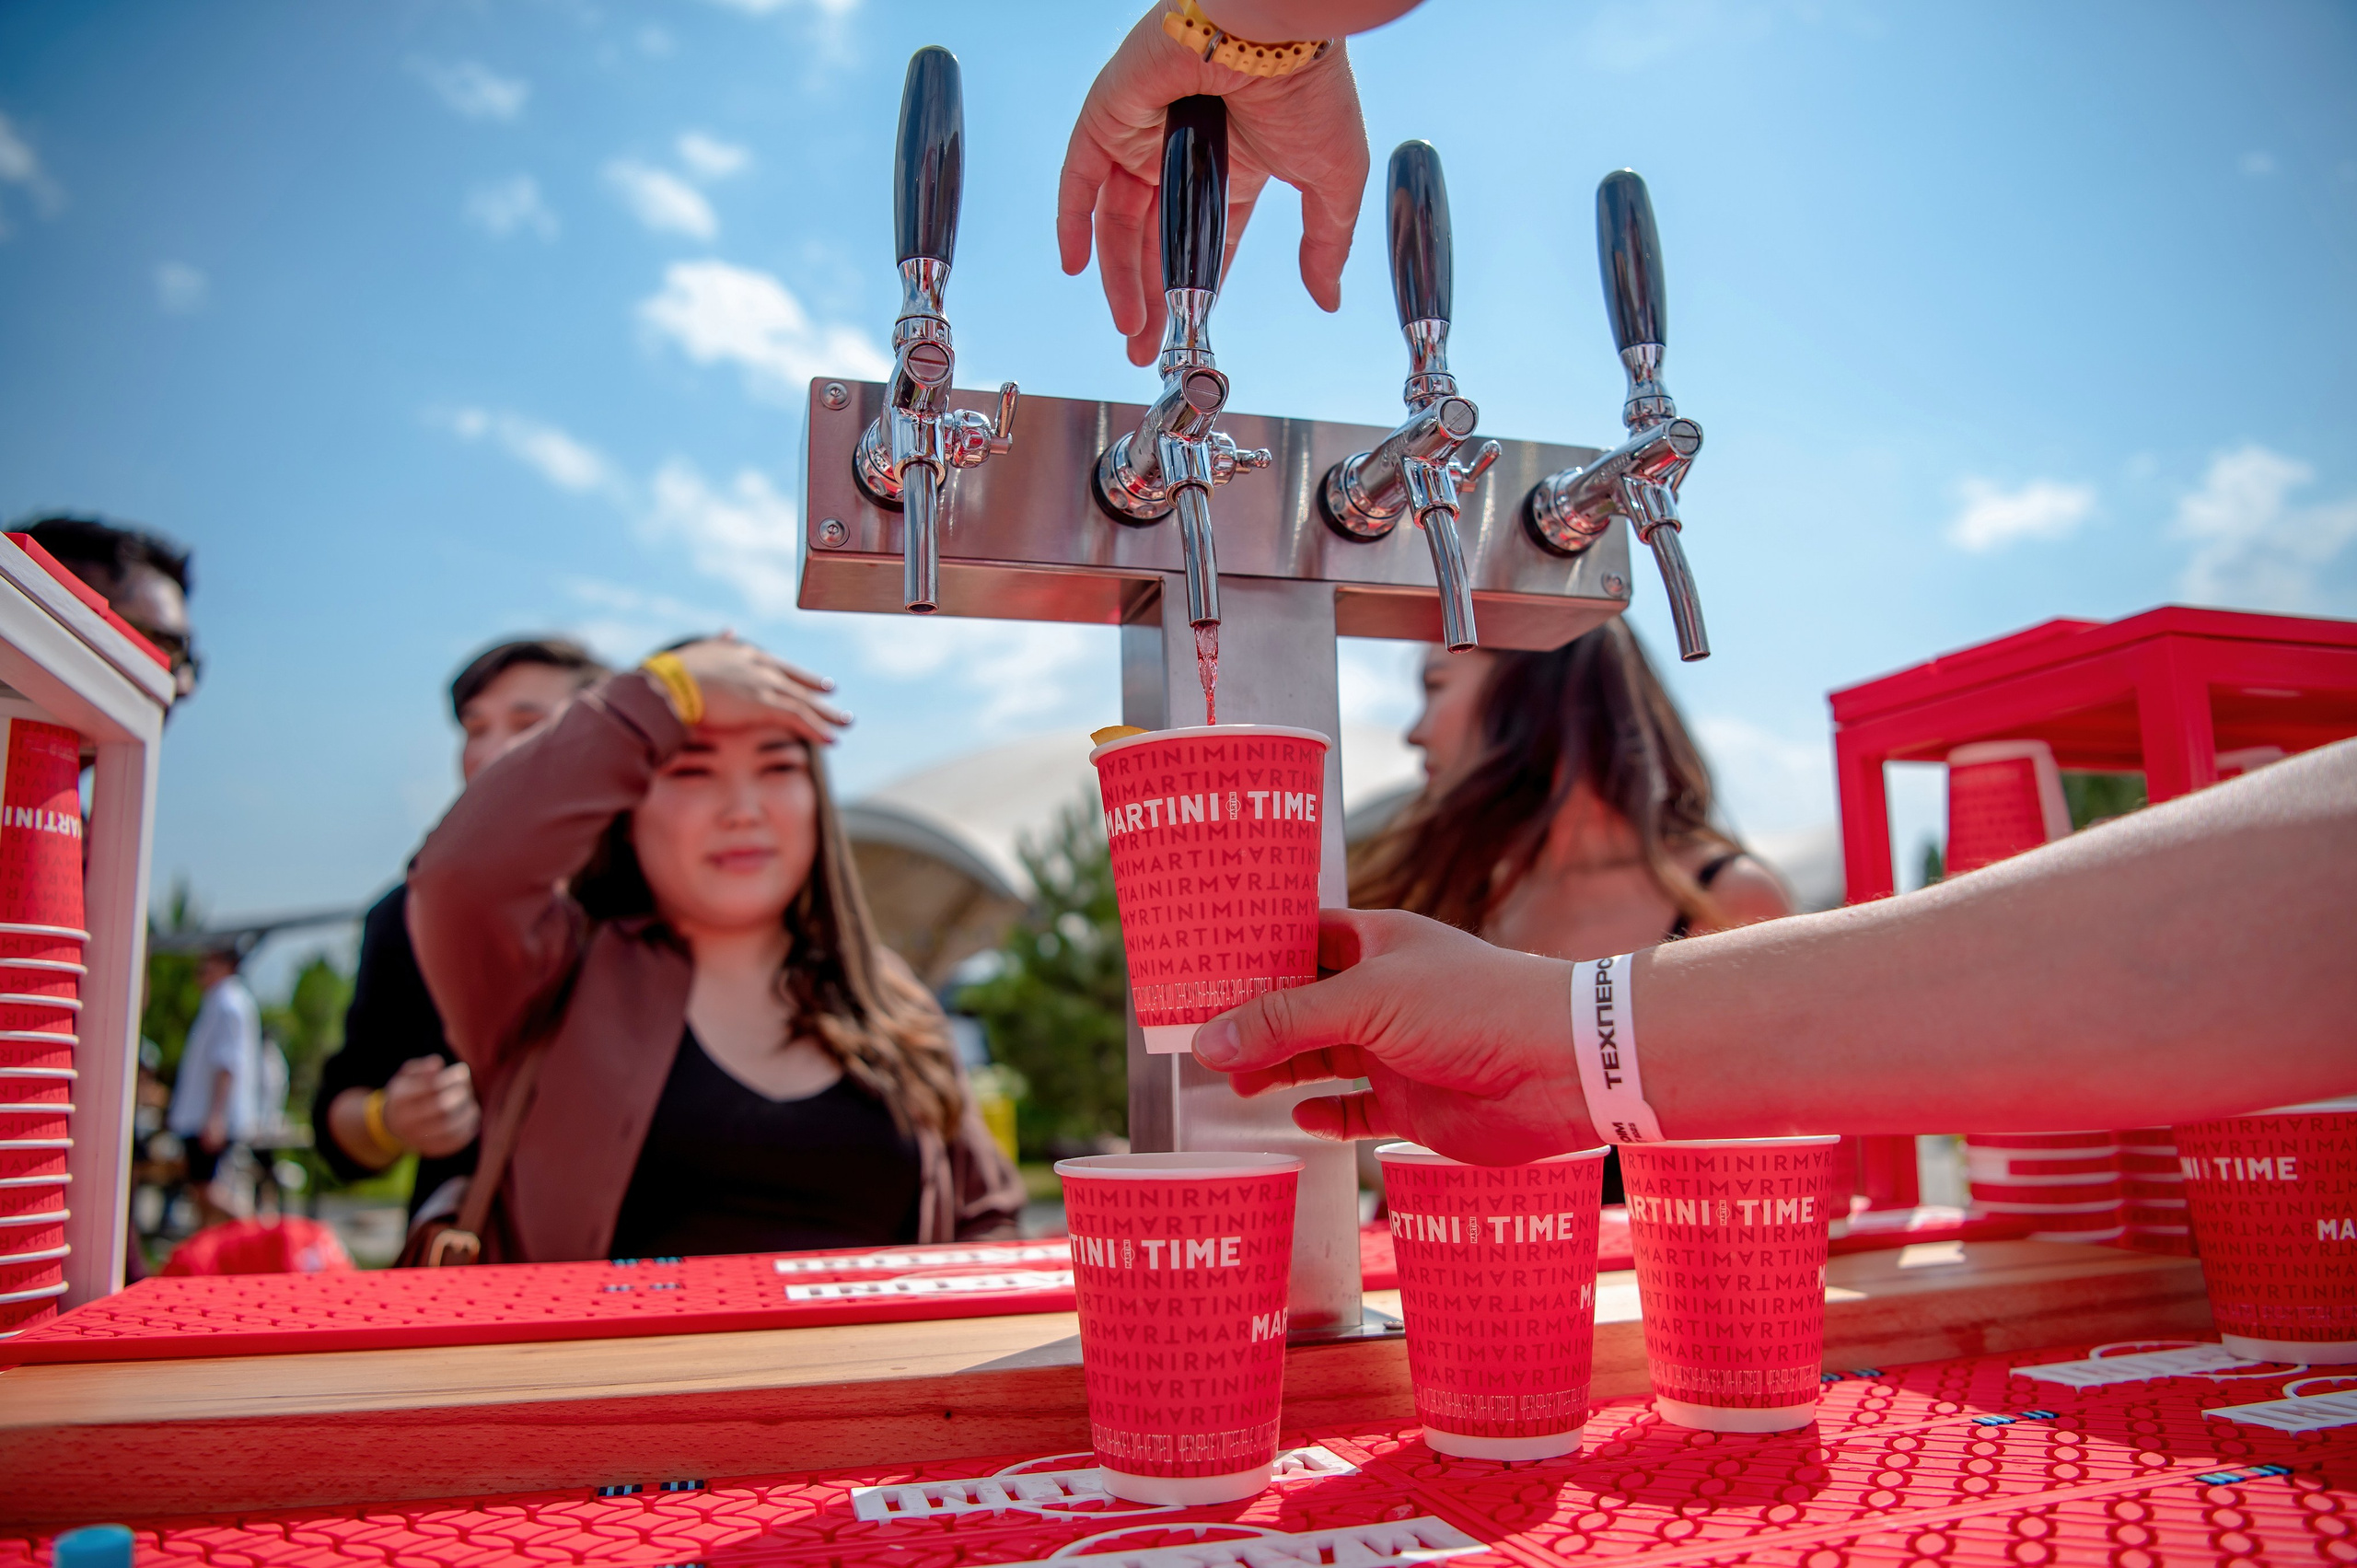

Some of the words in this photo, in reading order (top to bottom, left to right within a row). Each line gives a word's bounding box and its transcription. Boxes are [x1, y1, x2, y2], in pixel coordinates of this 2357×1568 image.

[1105, 792, 1220, 839] MARTINI
[1247, 790, 1317, 822] TIME
[2212, 1156, 2298, 1181] TIME
[1736, 1196, 1815, 1226] TIME
[1487, 1212, 1574, 1244] TIME
[1141, 1236, 1241, 1270] TIME
